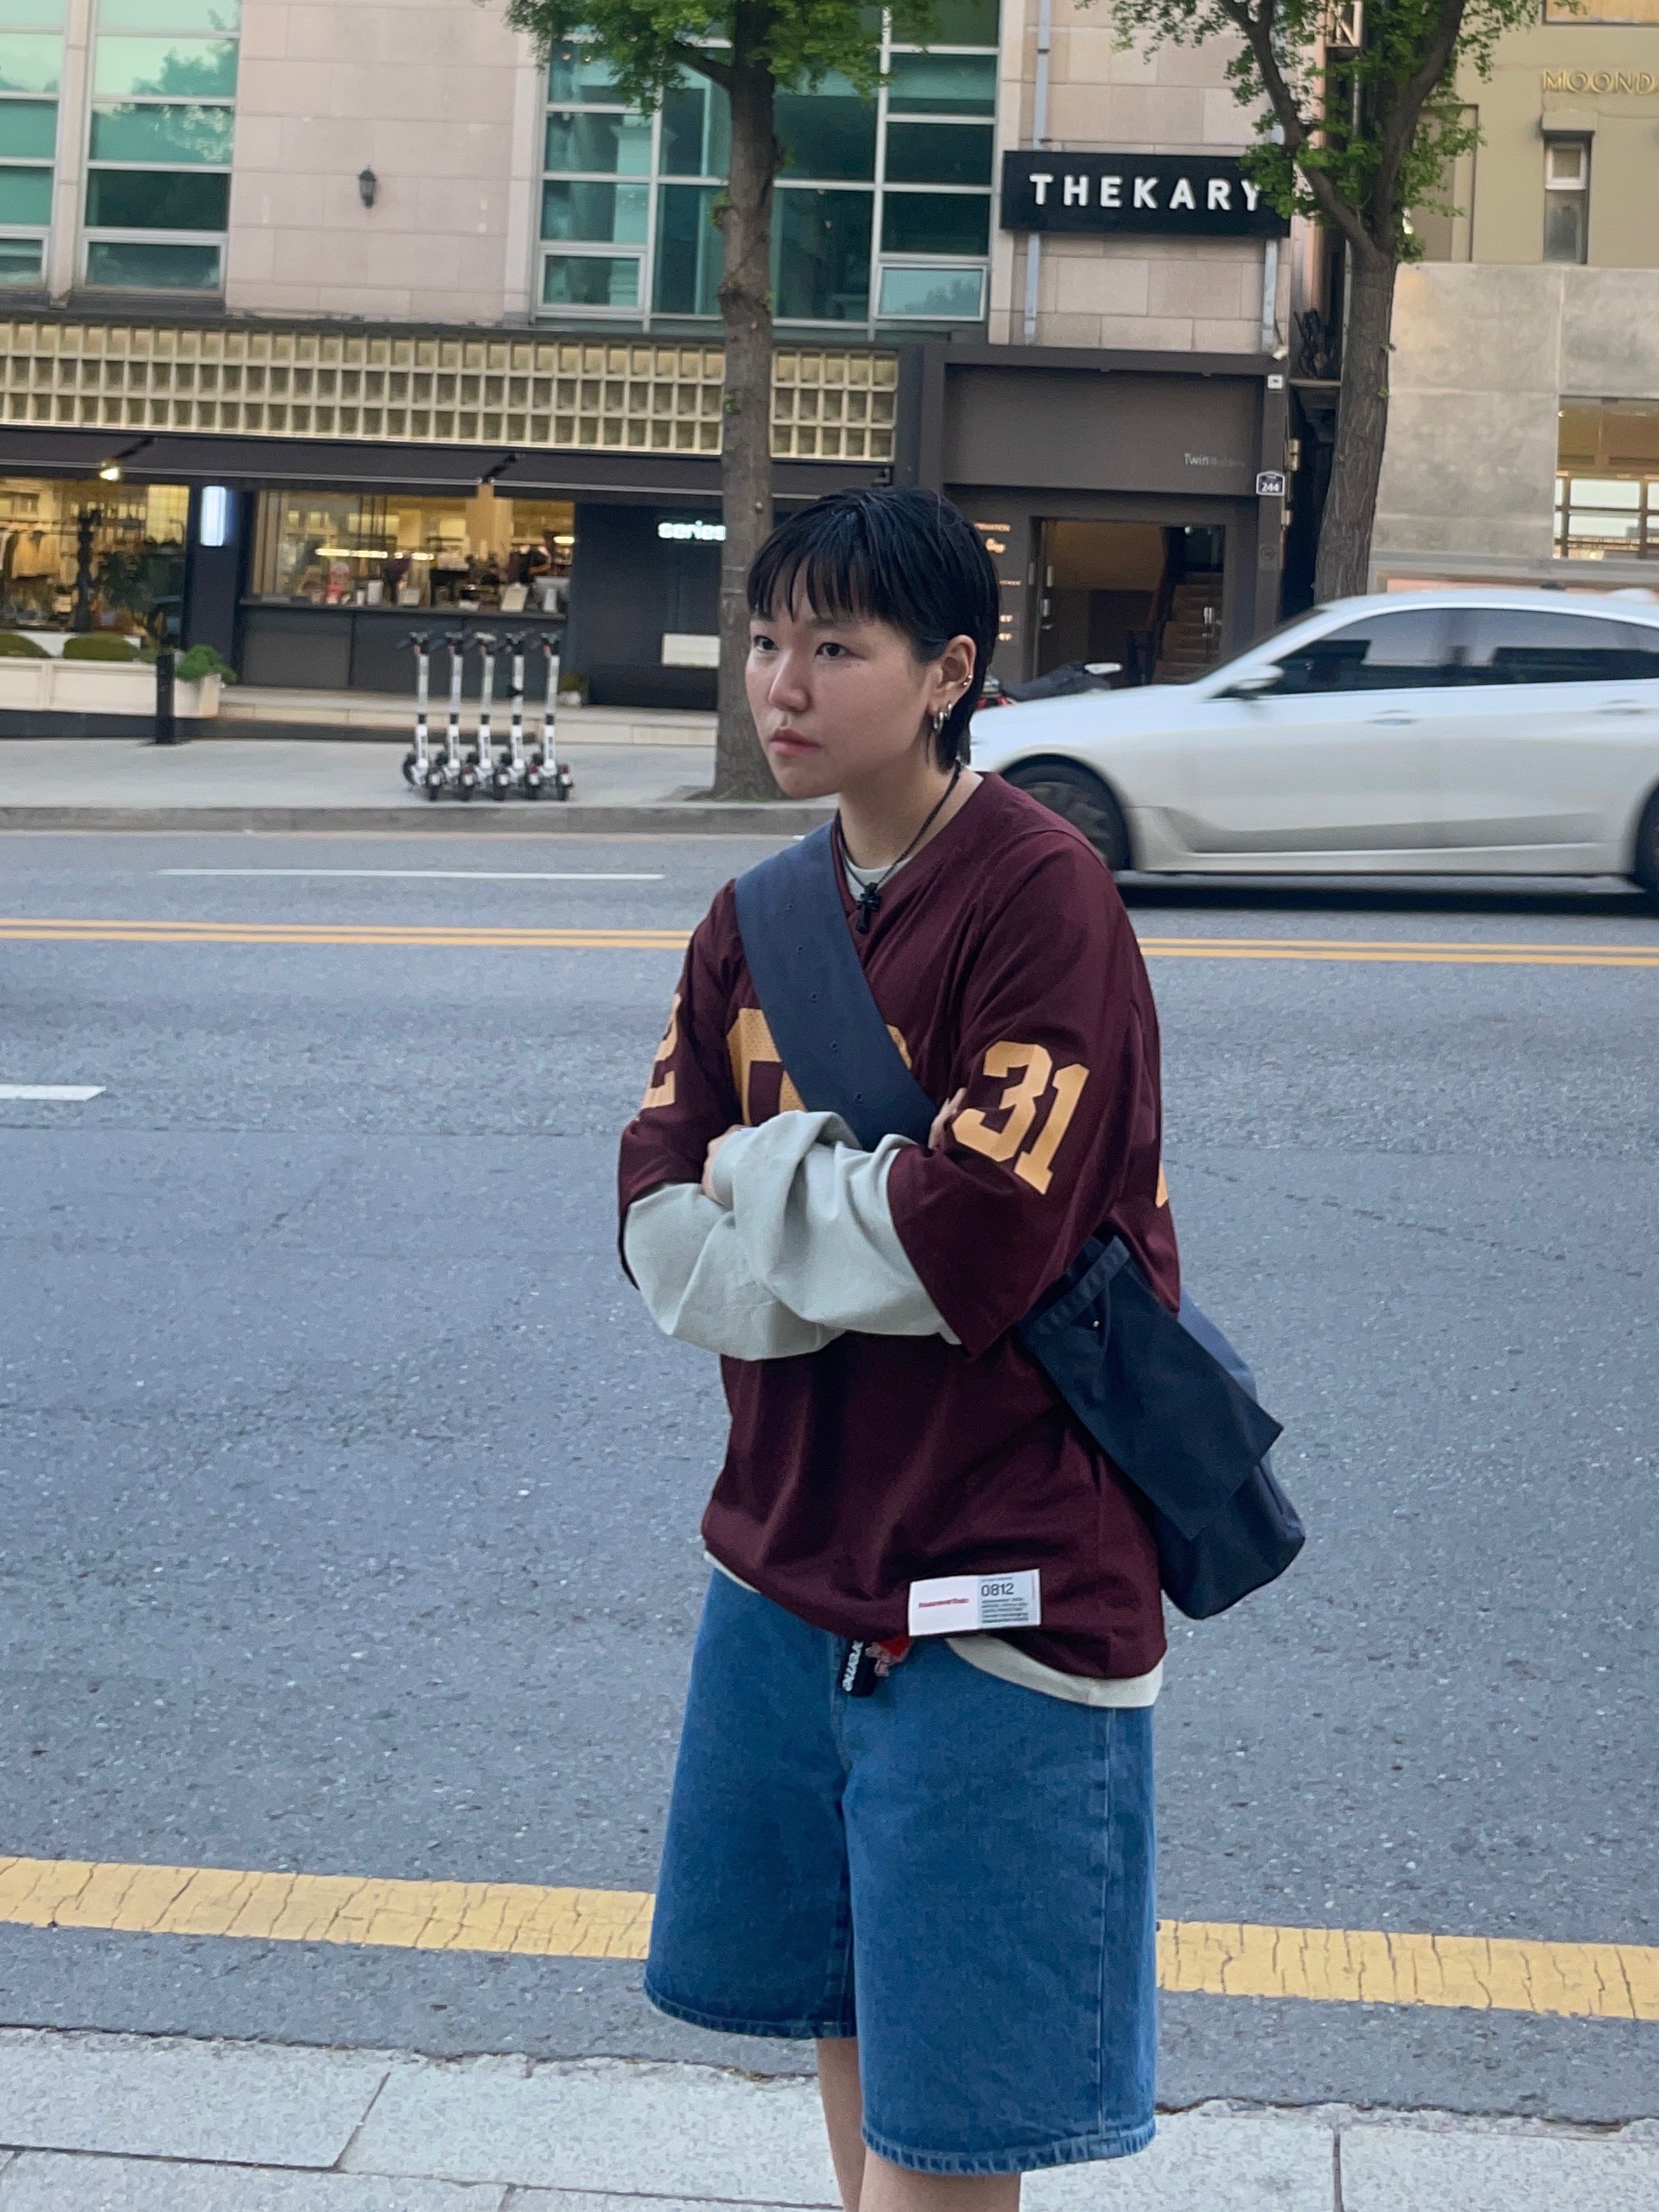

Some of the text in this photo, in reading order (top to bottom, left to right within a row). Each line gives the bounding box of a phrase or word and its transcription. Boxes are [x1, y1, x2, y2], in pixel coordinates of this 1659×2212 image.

[1542, 69, 1656, 95] MOOND
[1028, 173, 1261, 212] THEKARY
[1261, 482, 1280, 492] 244
[951, 1040, 1089, 1195] 31
[981, 1583, 1014, 1597] 0812
